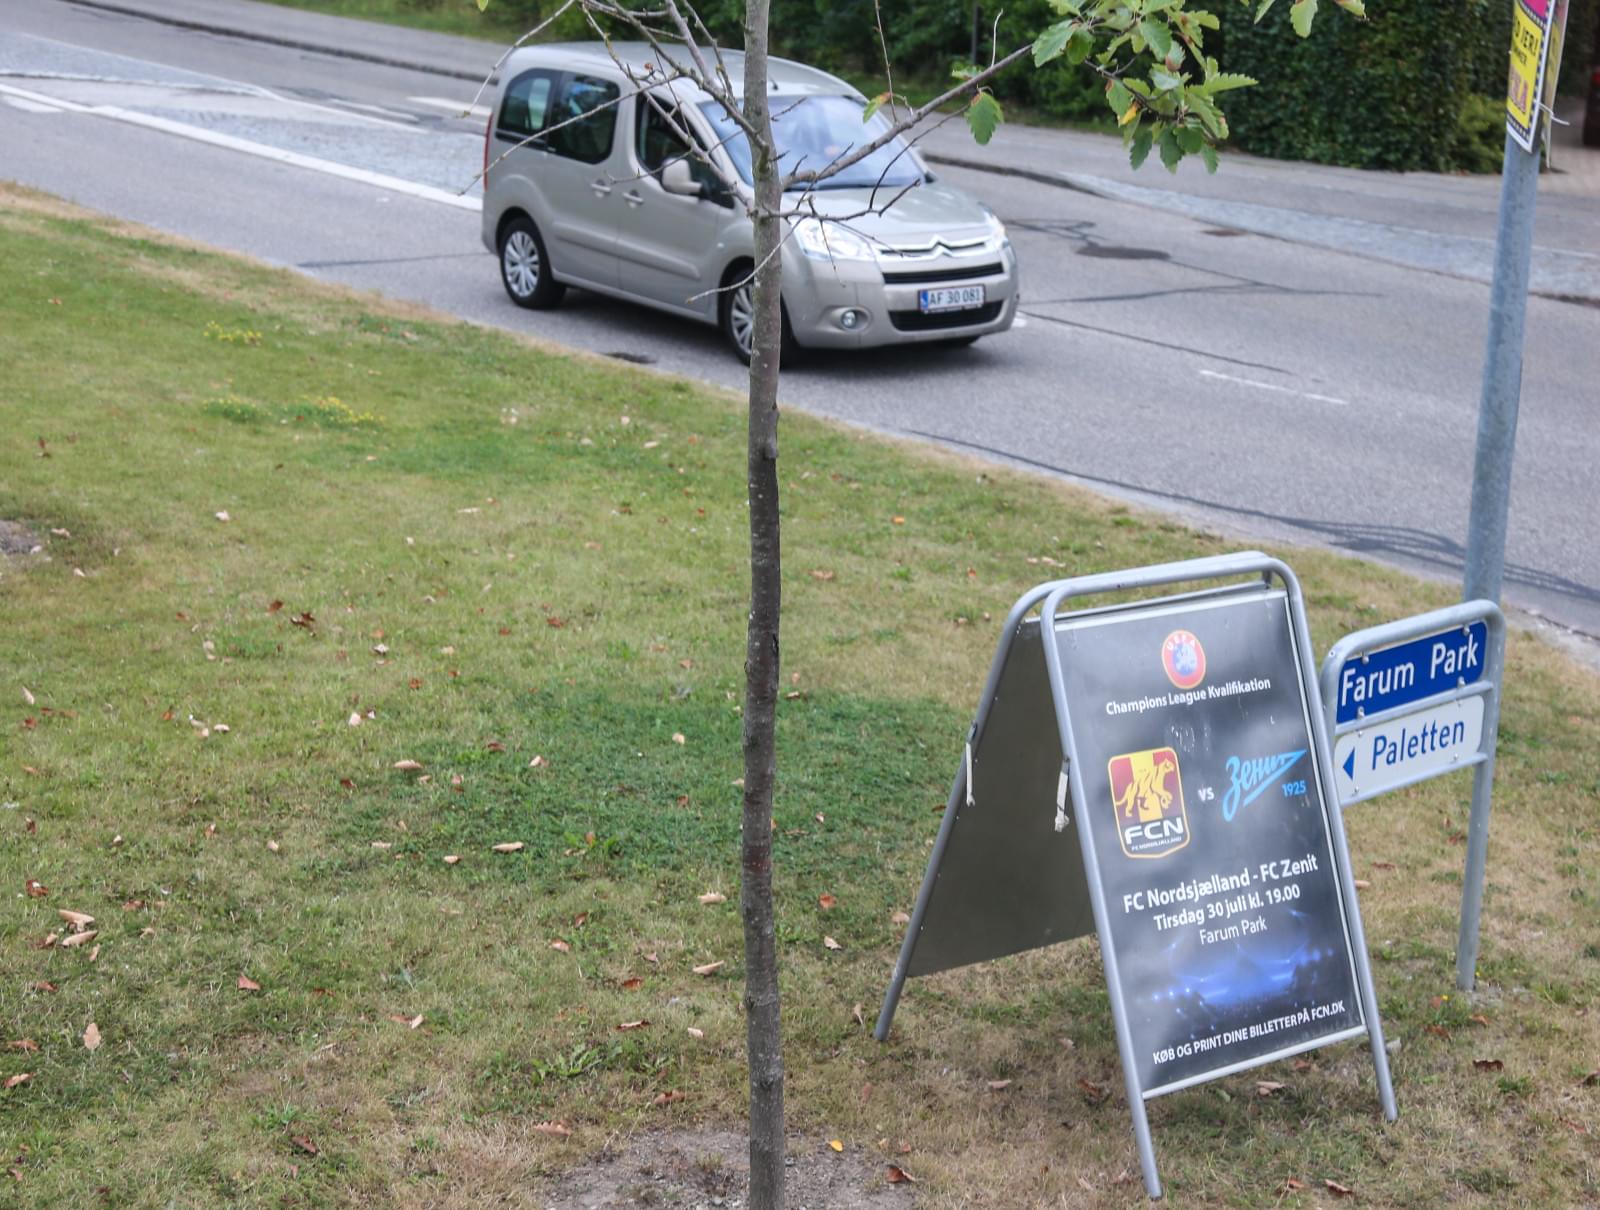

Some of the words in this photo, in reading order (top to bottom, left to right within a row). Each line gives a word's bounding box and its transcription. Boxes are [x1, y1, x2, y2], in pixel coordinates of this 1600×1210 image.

[930, 291, 943, 305] AF
[947, 290, 960, 304] 30
[962, 287, 980, 303] 081
[1341, 661, 1415, 707] Farum
[1430, 633, 1479, 680] Park
[1106, 697, 1168, 716] Champions
[1168, 688, 1207, 706] League
[1207, 677, 1272, 700] Kvalifikation
[1371, 719, 1465, 771] Paletten
[1281, 780, 1307, 797] 1925
[1125, 816, 1184, 845] FCN
[1123, 891, 1144, 913] FC
[1147, 867, 1251, 906] Nordsjælland
[1260, 862, 1280, 883] FC
[1281, 853, 1318, 878] Zenit
[1153, 910, 1205, 930] Tirsdag
[1207, 902, 1225, 920] 30
[1226, 897, 1248, 918] juli
[1249, 889, 1265, 909] kl.
[1266, 883, 1300, 904] 19.00
[1199, 926, 1240, 945] Farum
[1241, 916, 1268, 935] Park
[1152, 1048, 1176, 1065] KØB
[1176, 1043, 1193, 1057] OG
[1193, 1034, 1223, 1053] PRINT
[1223, 1027, 1249, 1045] DINE
[1249, 1013, 1297, 1037] BILLETTER
[1311, 1000, 1346, 1018] FCN.DK
